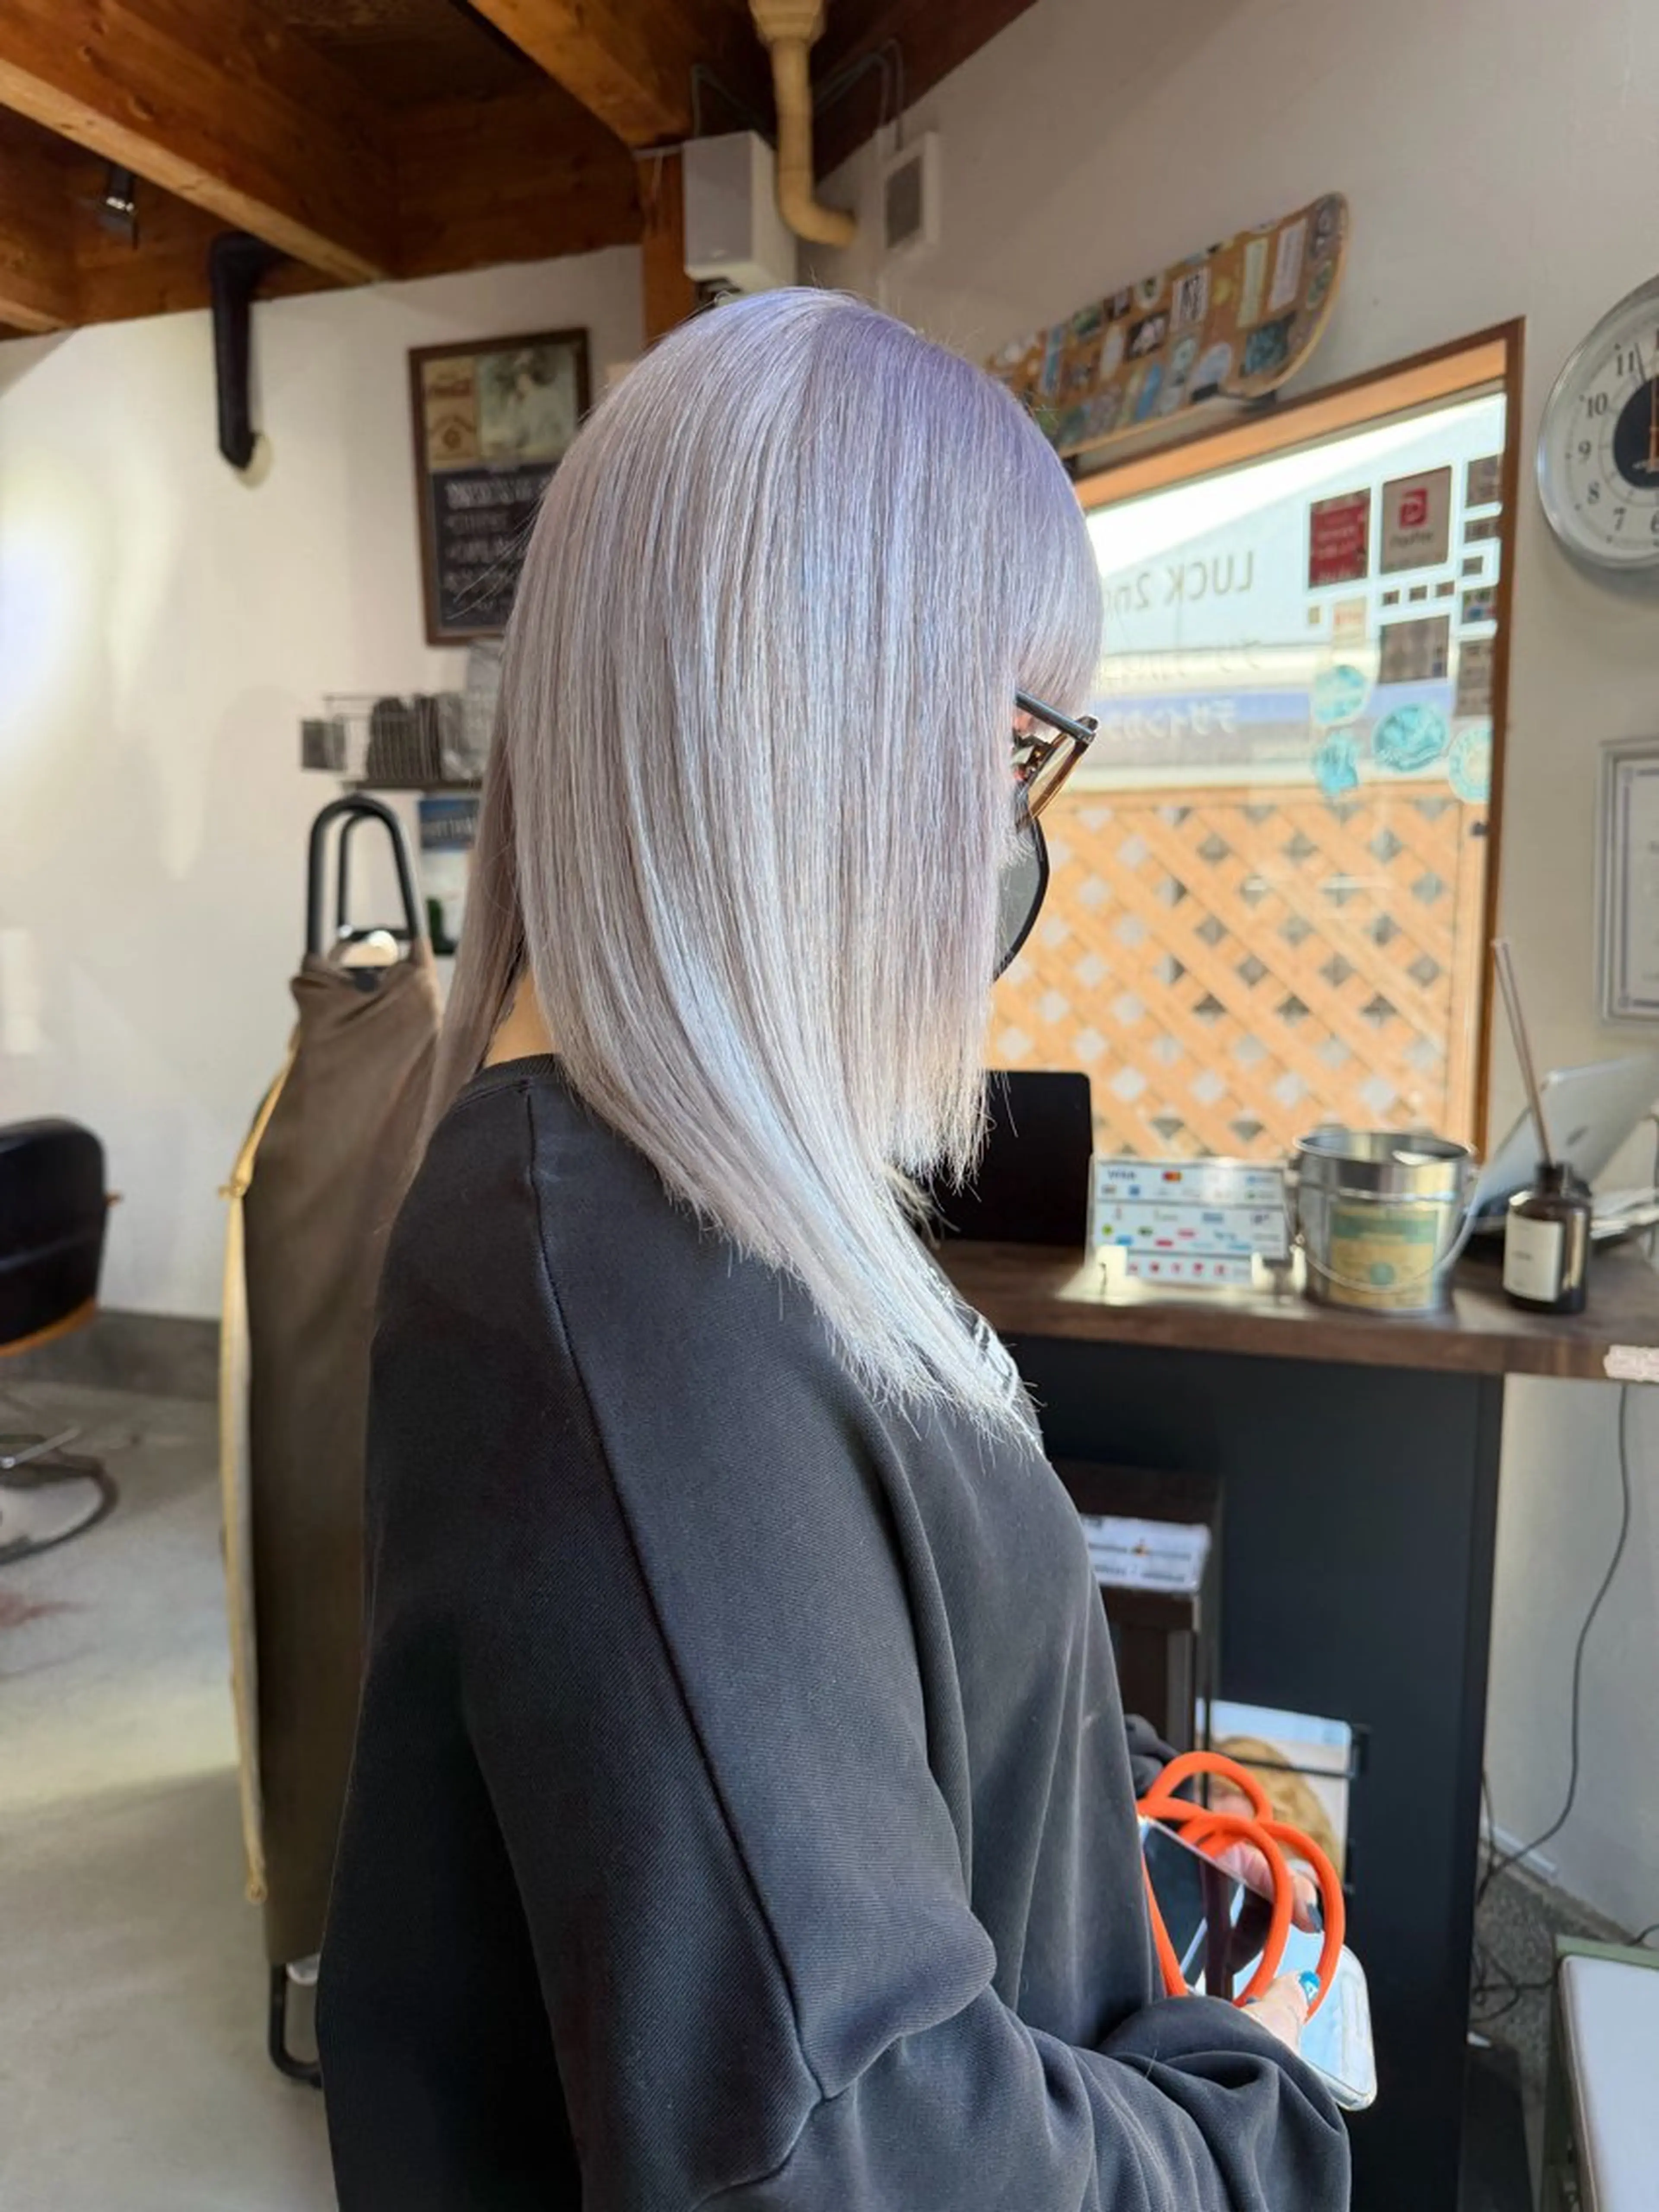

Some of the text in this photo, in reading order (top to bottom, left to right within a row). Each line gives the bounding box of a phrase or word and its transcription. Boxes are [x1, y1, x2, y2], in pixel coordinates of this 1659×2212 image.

[1615, 350, 1635, 376] 11
[1586, 392, 1608, 418] 10
[1578, 440, 1592, 464] 9
[1587, 481, 1600, 504] 8
[1613, 507, 1627, 531] 7
